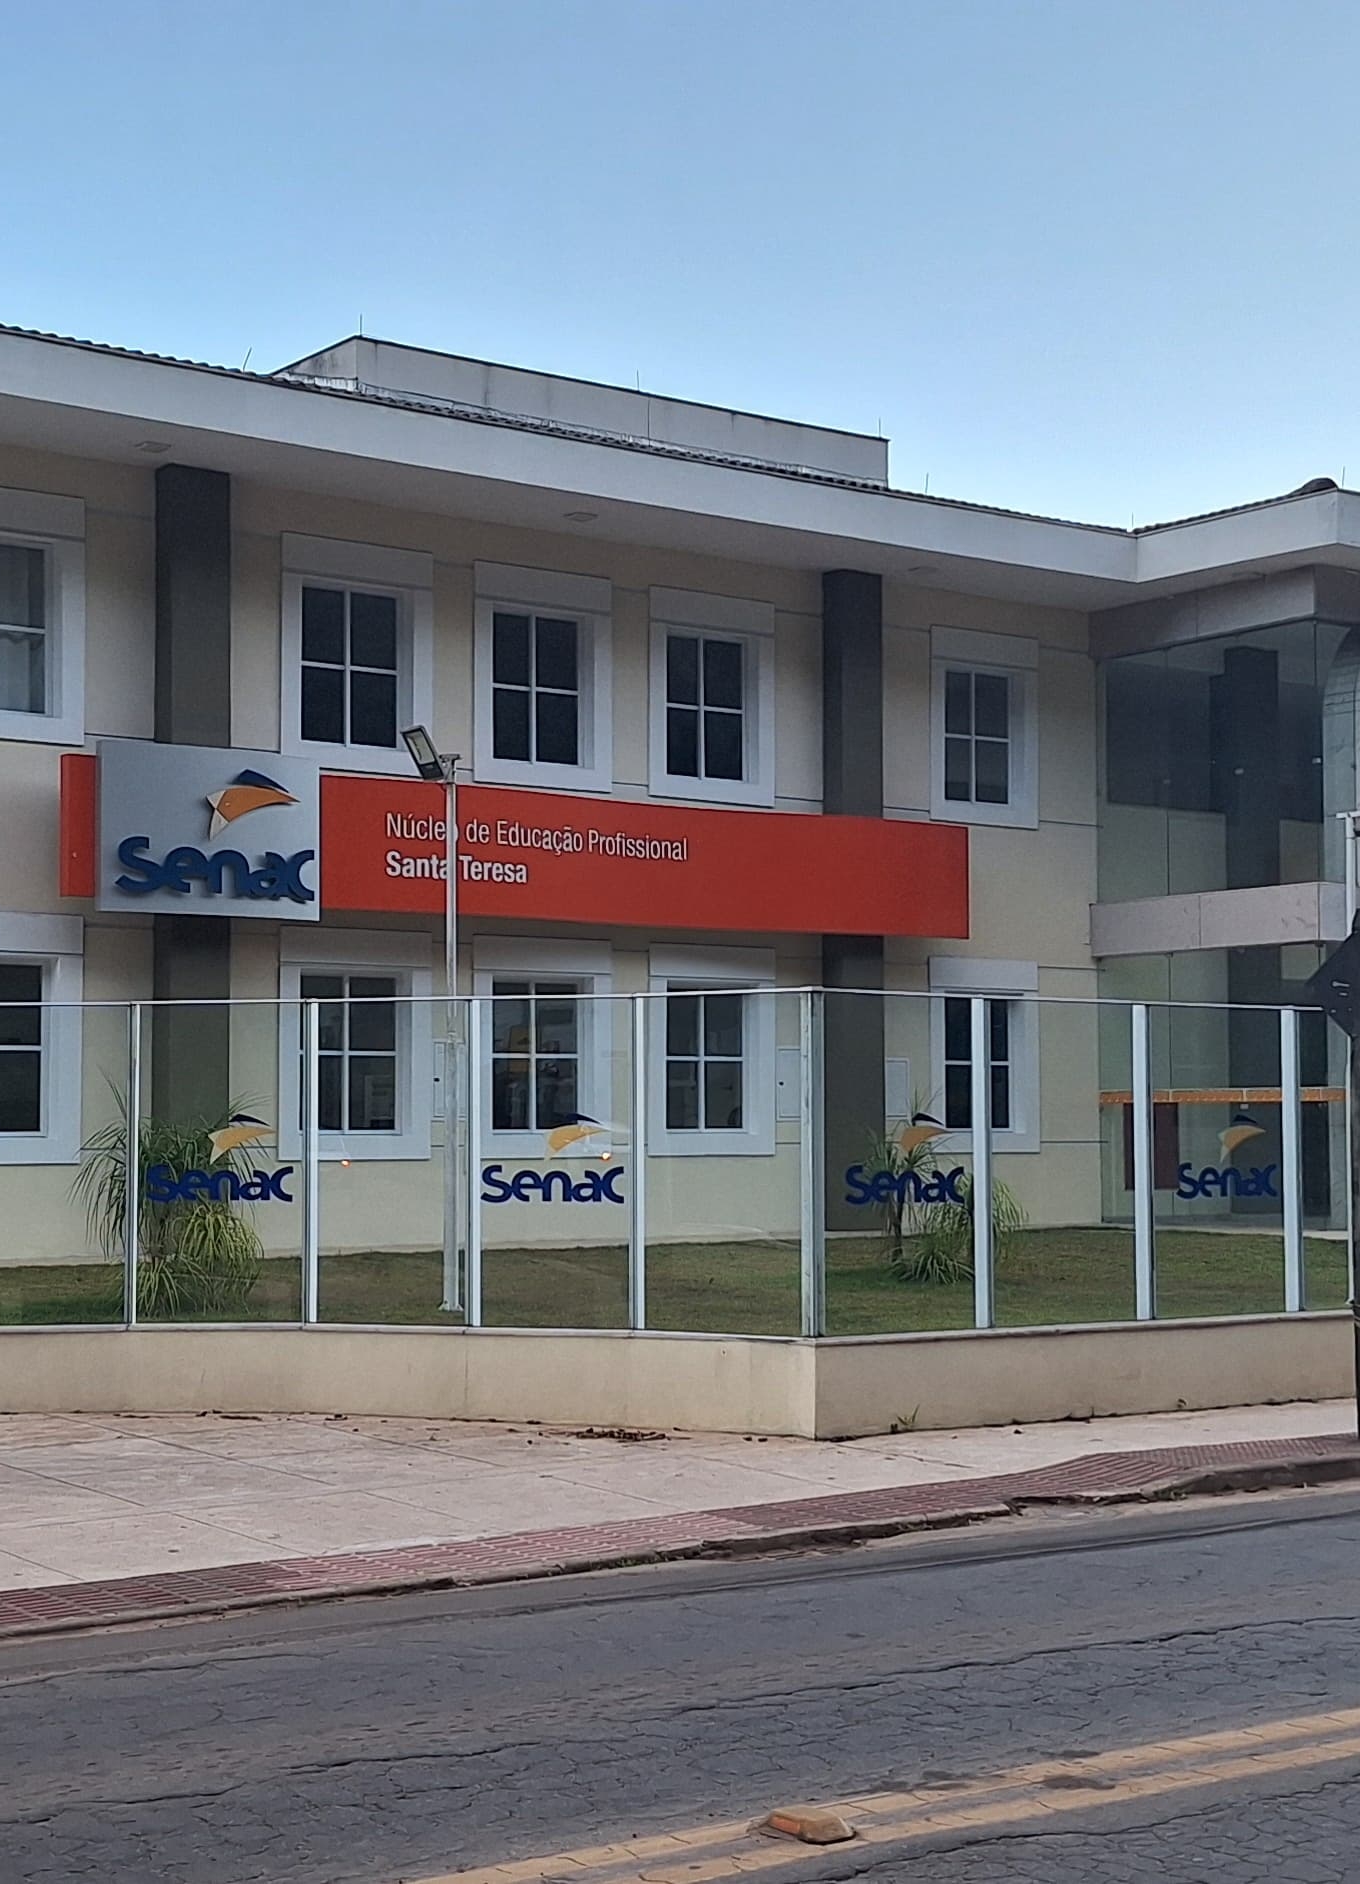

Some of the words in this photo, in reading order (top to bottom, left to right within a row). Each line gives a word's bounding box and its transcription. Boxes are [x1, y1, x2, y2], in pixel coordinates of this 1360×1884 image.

[386, 811, 459, 841] Núcle
[466, 818, 490, 843] de
[497, 820, 583, 856] Educação
[588, 829, 688, 861] Profissional
[459, 854, 528, 884] Teresa
